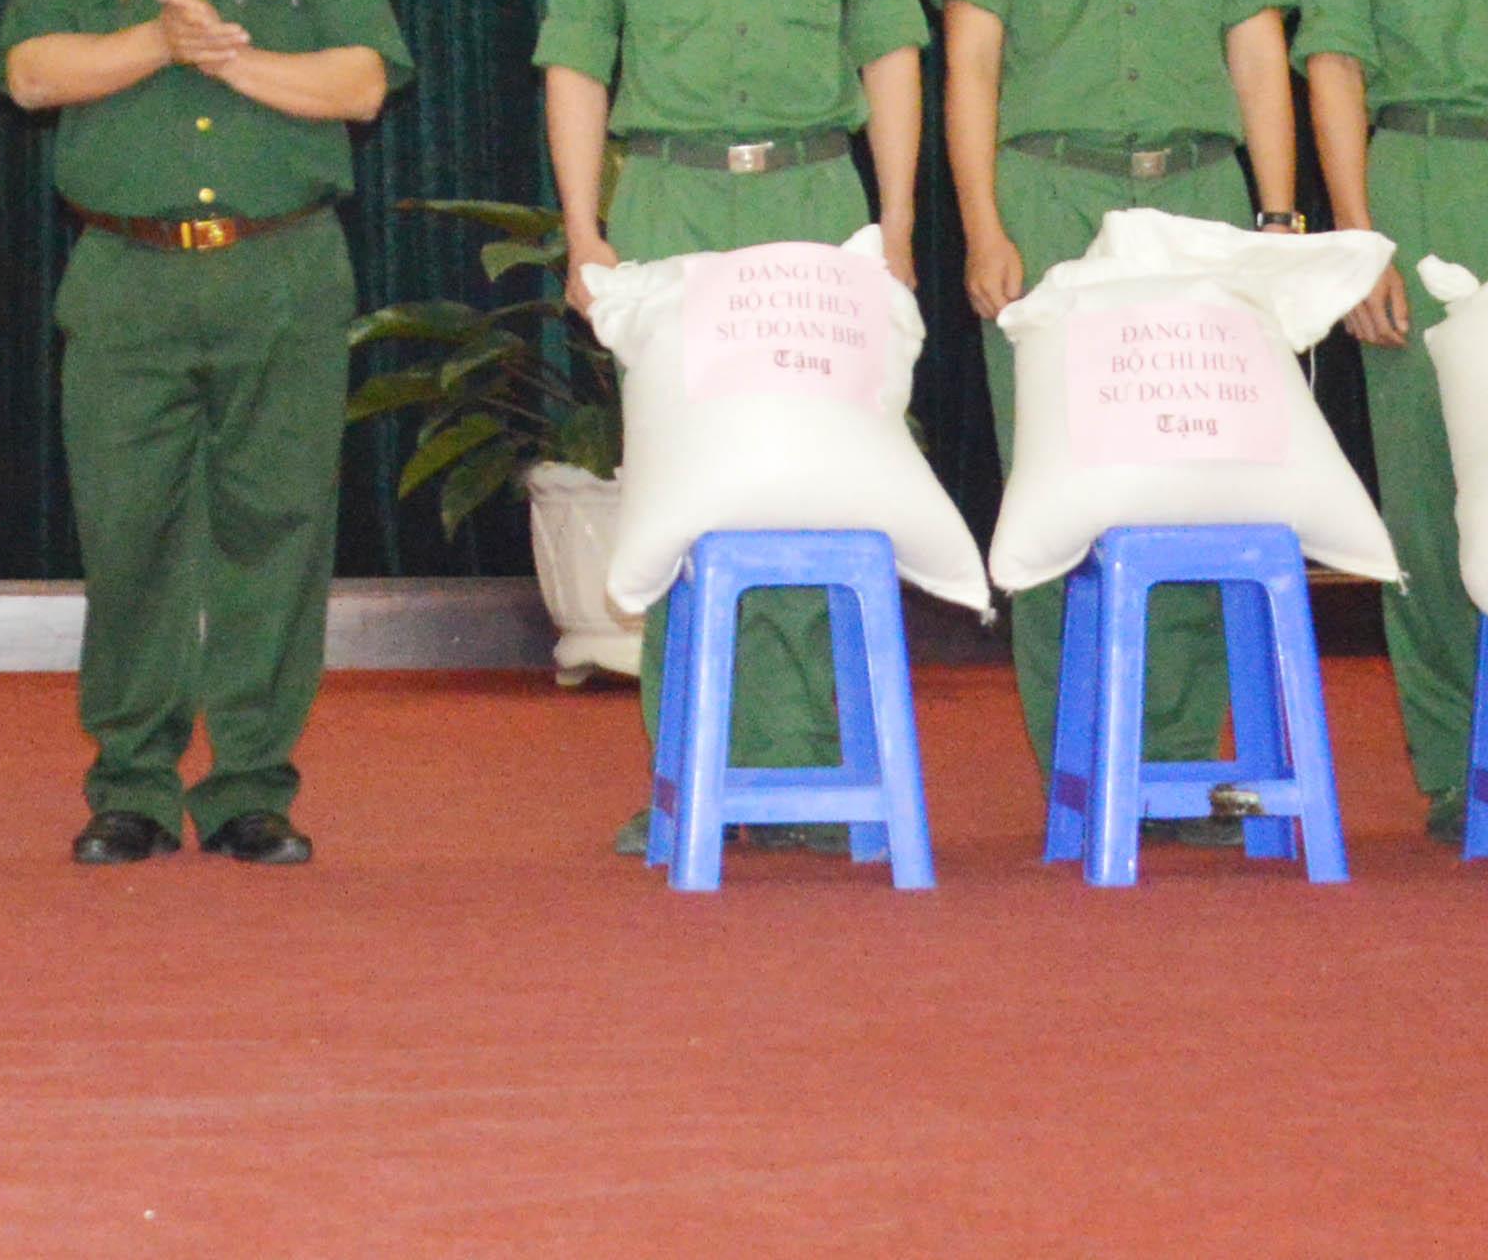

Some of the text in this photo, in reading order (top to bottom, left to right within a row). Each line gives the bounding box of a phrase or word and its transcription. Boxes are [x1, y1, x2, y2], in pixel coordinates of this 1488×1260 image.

[817, 293, 862, 318] HUY
[831, 324, 867, 349] BB5
[1200, 351, 1248, 374] HUY
[1217, 382, 1261, 404] BB5
